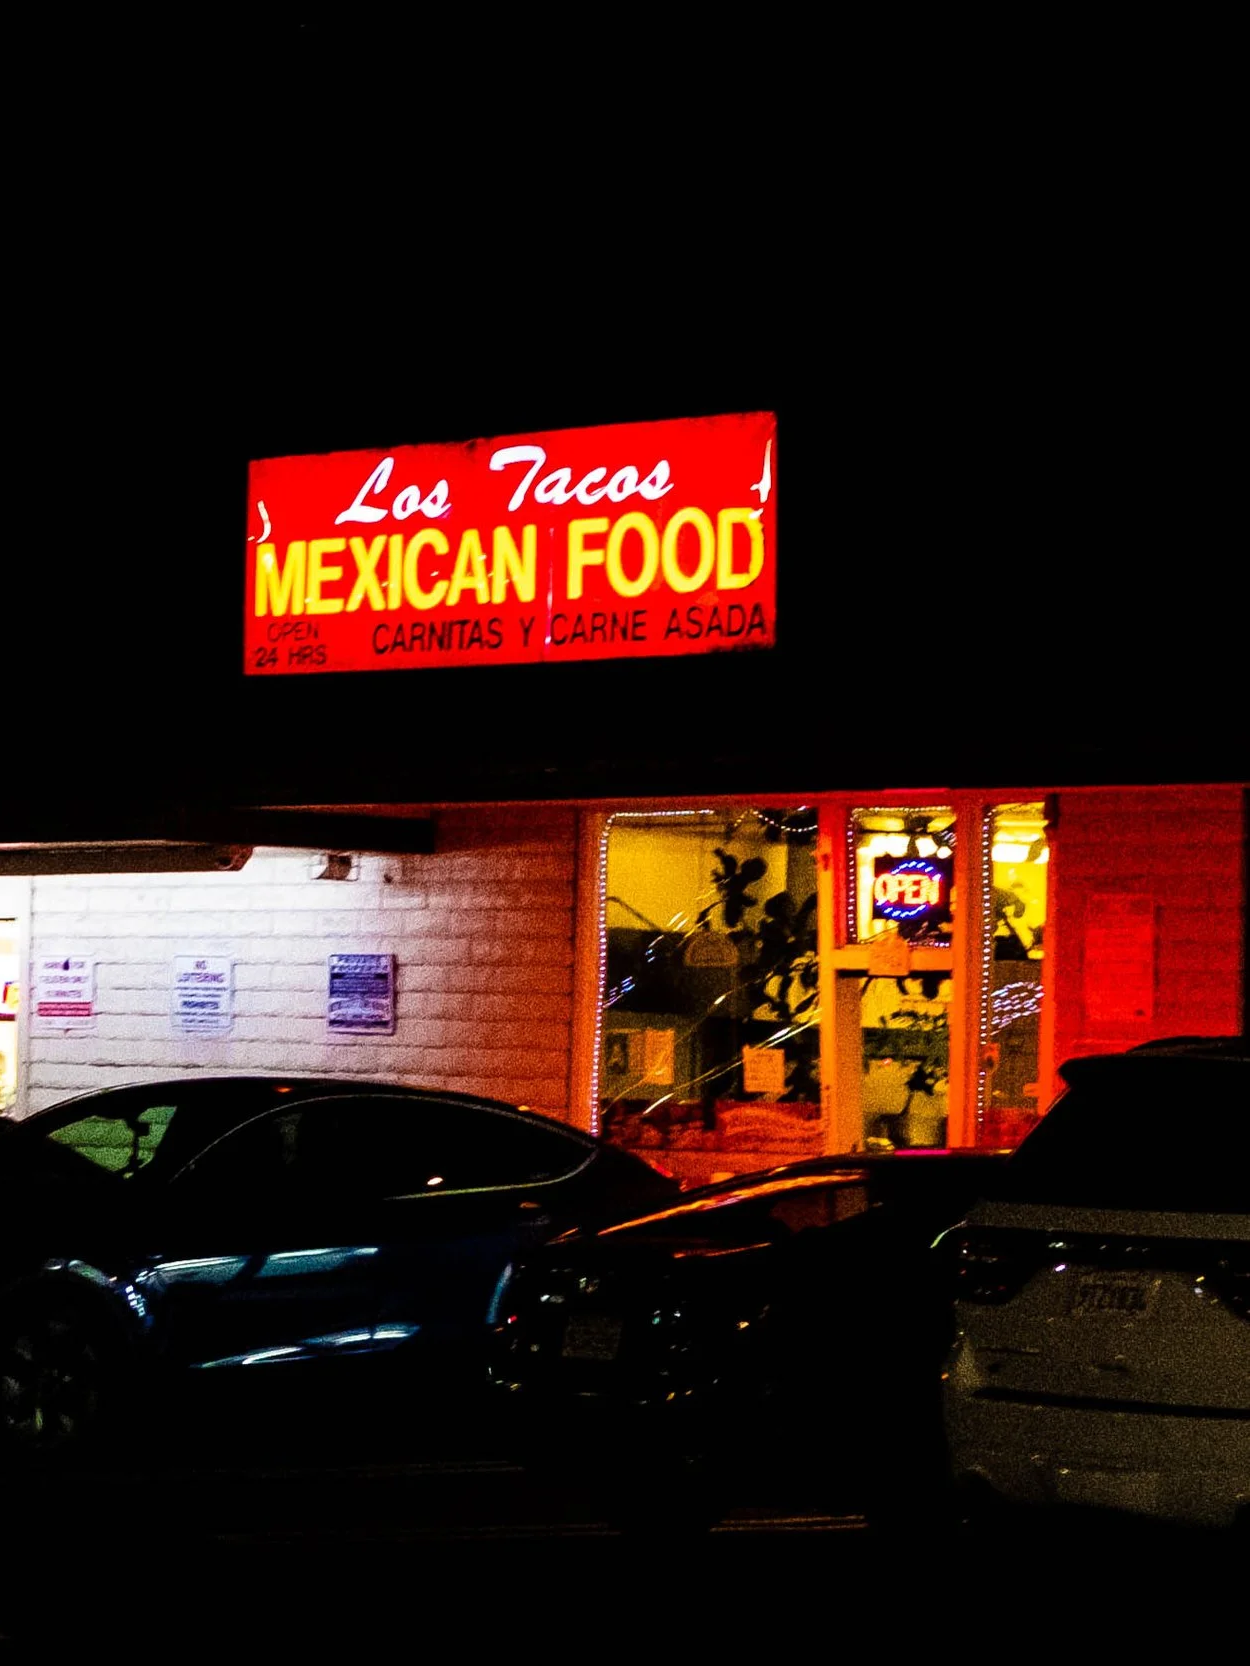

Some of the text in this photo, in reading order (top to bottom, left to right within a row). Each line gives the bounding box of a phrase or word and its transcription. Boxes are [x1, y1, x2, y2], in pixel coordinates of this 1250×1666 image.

[335, 445, 674, 525] Los Tacos
[255, 506, 765, 617] MEXICAN FOOD
[267, 621, 320, 643] OPEN
[372, 602, 767, 654] CARNITAS Y CARNE ASADA
[255, 644, 327, 668] 24 HRS
[874, 873, 939, 905] OPEN
